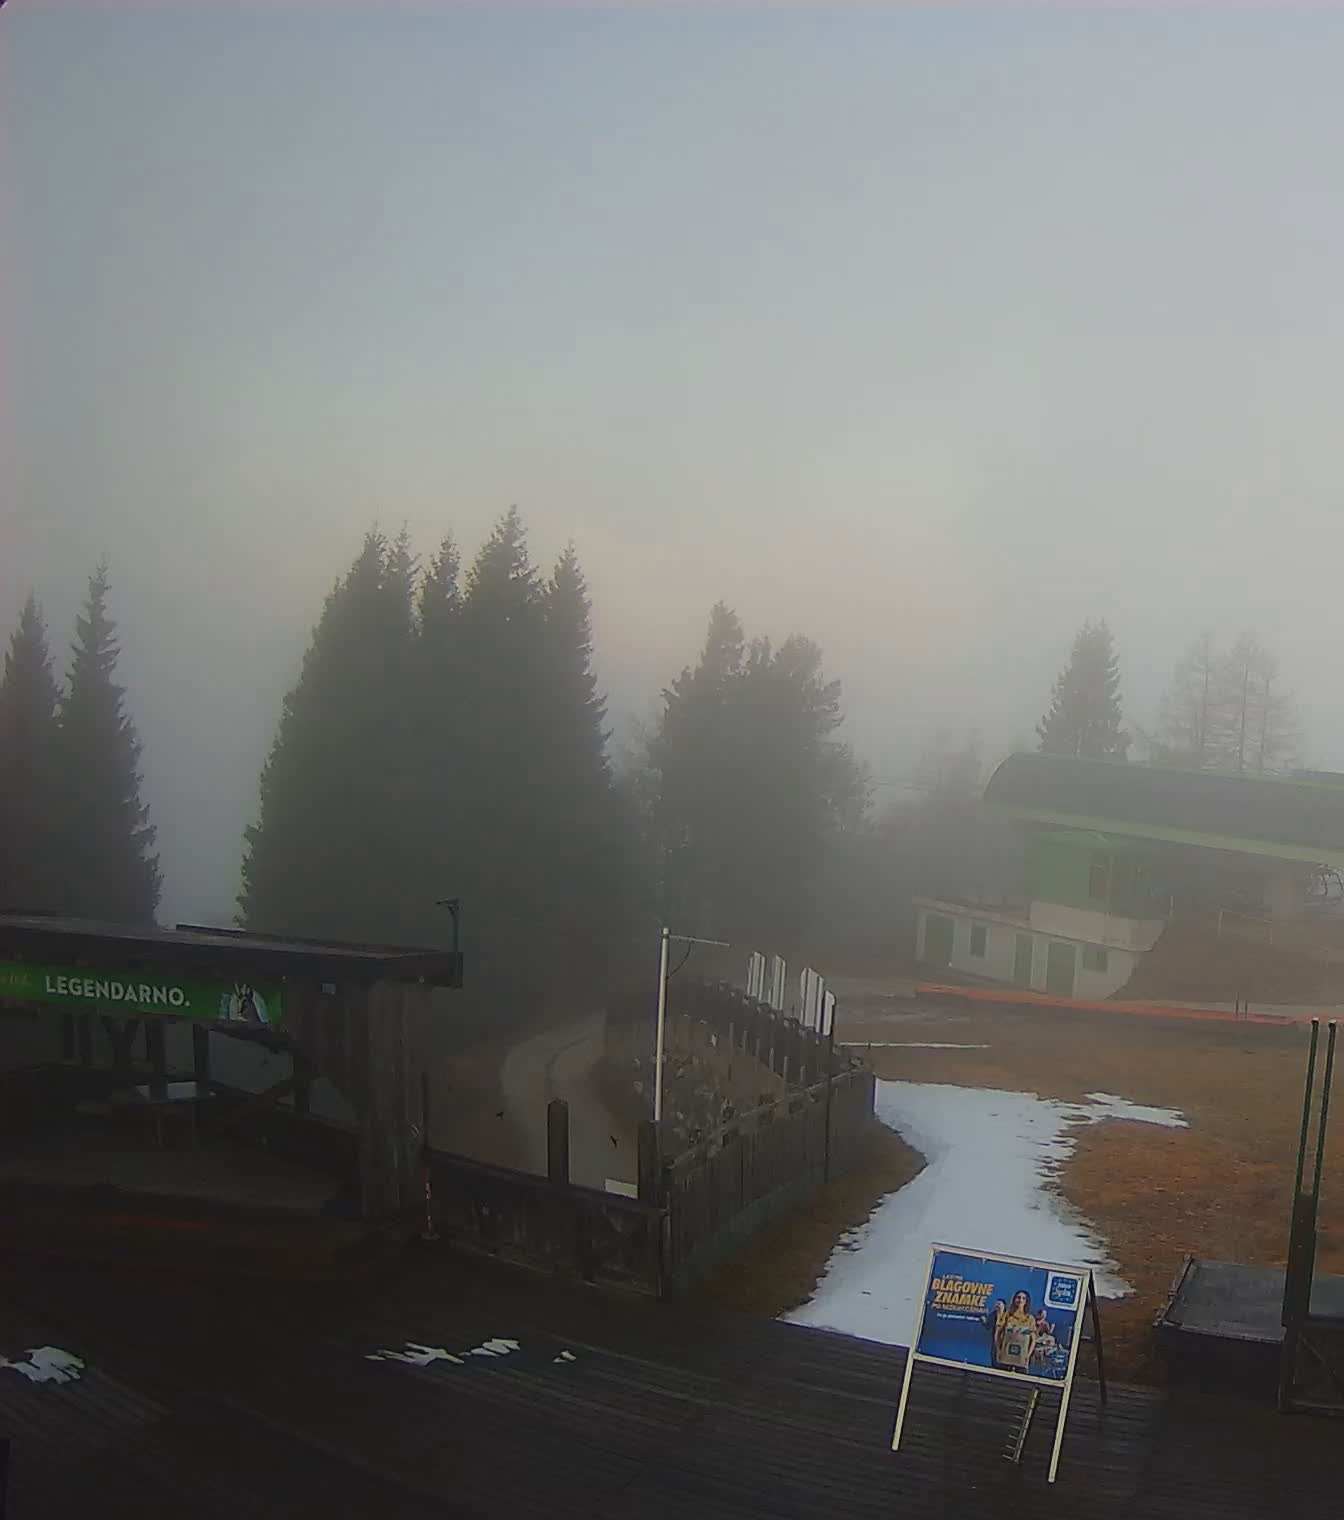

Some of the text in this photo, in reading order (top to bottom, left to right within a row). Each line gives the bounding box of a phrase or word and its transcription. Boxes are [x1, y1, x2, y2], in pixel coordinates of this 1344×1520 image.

[45, 975, 191, 1007] LEGENDARNO.
[931, 1278, 994, 1295] BLAGOVNE
[934, 1291, 987, 1307] ZNAMKE
